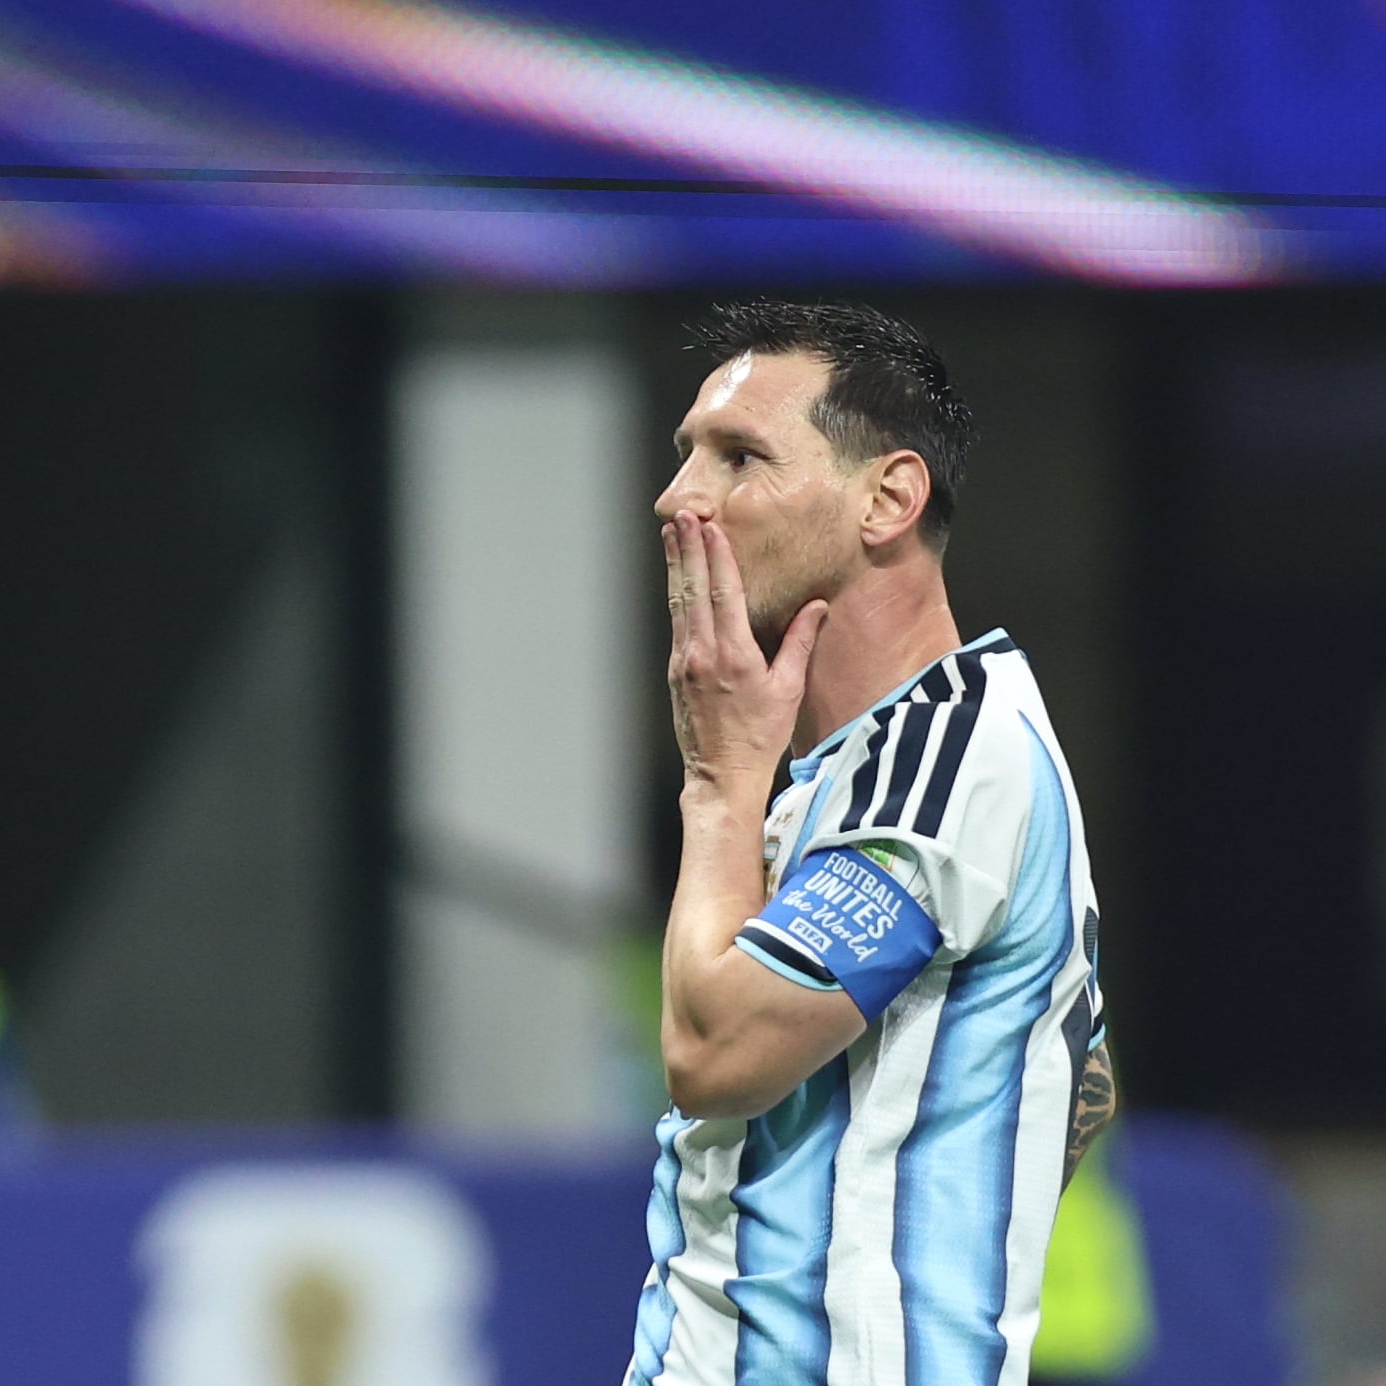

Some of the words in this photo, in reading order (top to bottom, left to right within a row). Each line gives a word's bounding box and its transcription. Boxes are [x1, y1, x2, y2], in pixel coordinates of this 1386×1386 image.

[803, 869, 894, 940] UNITES
[823, 851, 903, 922] FOOTBALL
[781, 889, 813, 913] the
[811, 903, 879, 963] World
[792, 918, 828, 950] FIFA
